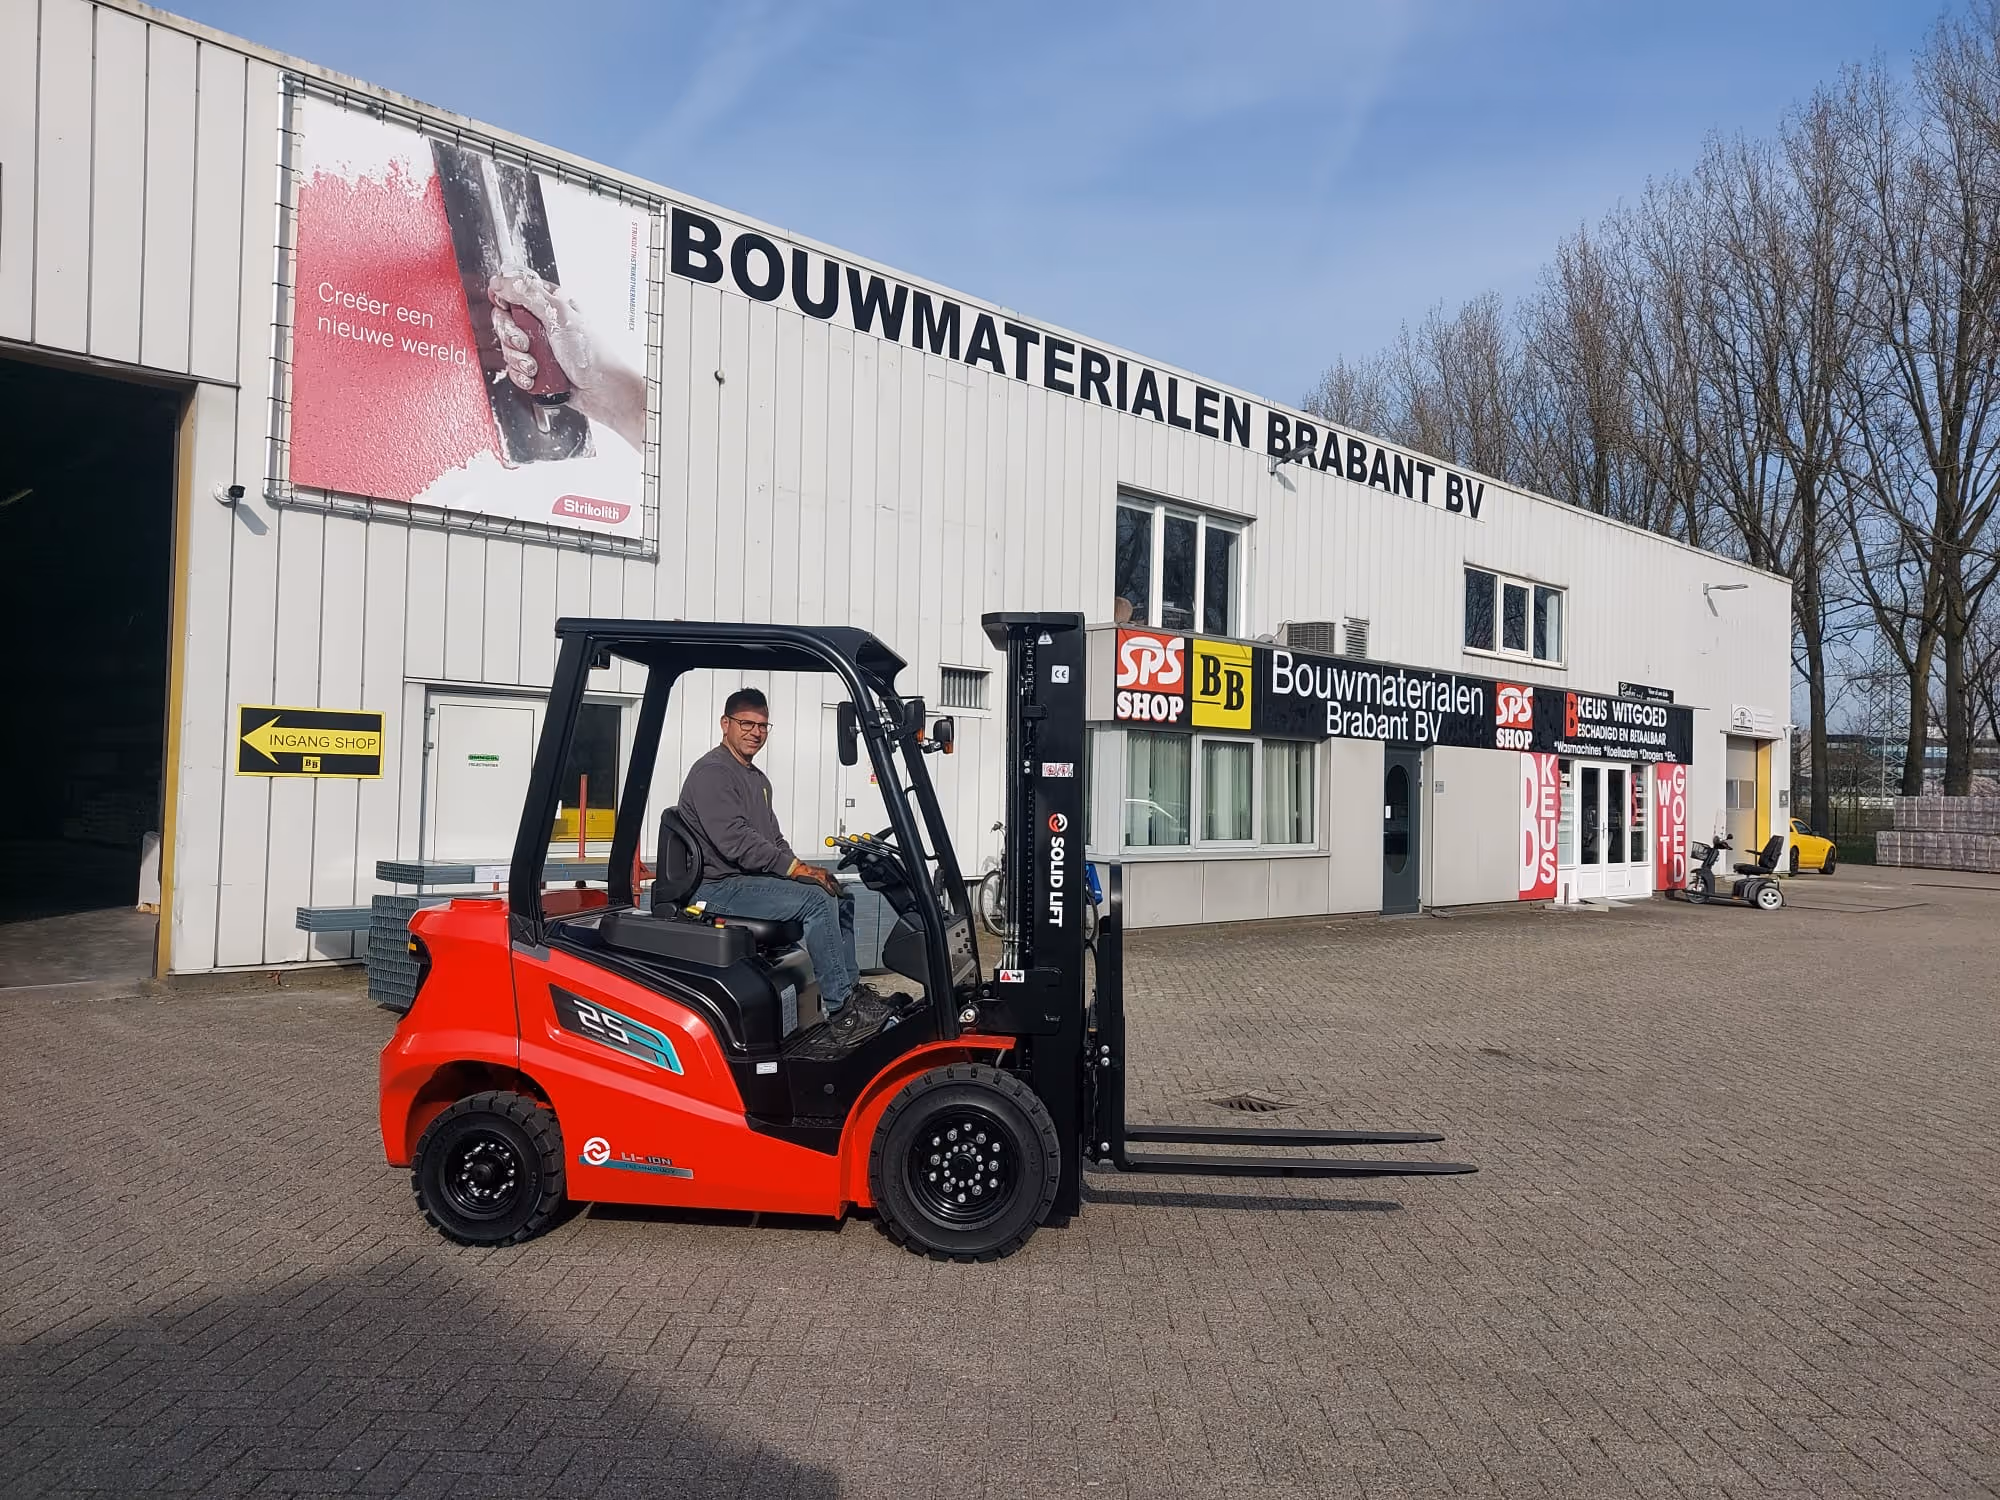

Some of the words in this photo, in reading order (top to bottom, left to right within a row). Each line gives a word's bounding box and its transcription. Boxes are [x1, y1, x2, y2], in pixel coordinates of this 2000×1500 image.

[318, 282, 390, 316] Creëer
[396, 306, 433, 328] een
[318, 315, 394, 348] nieuwe
[401, 336, 472, 369] wereld.
[671, 206, 1251, 449] BOUWMATERIALEN
[1267, 411, 1435, 503] BRABANT
[1446, 472, 1484, 519] BV
[563, 499, 620, 520] Strikolith
[1117, 637, 1185, 687] SPS
[1272, 650, 1484, 716] Bouwmaterialen
[1117, 691, 1184, 723] SHOP
[1327, 701, 1408, 740] Brabant
[1415, 711, 1442, 743] BV
[1496, 687, 1534, 725] SPS
[1612, 701, 1667, 728] WITGOED
[269, 734, 330, 749] INGANG
[334, 737, 376, 750] SHOP
[1496, 728, 1533, 750] SHOP
[1619, 728, 1629, 742] EN
[1630, 728, 1666, 746] BETAALBAAR
[1540, 754, 1556, 884] KEUS
[1658, 779, 1671, 864] WIT
[1672, 765, 1685, 882] GOED
[1050, 837, 1065, 888] SOLID
[1049, 892, 1063, 927] LIFT
[573, 999, 629, 1044] 25
